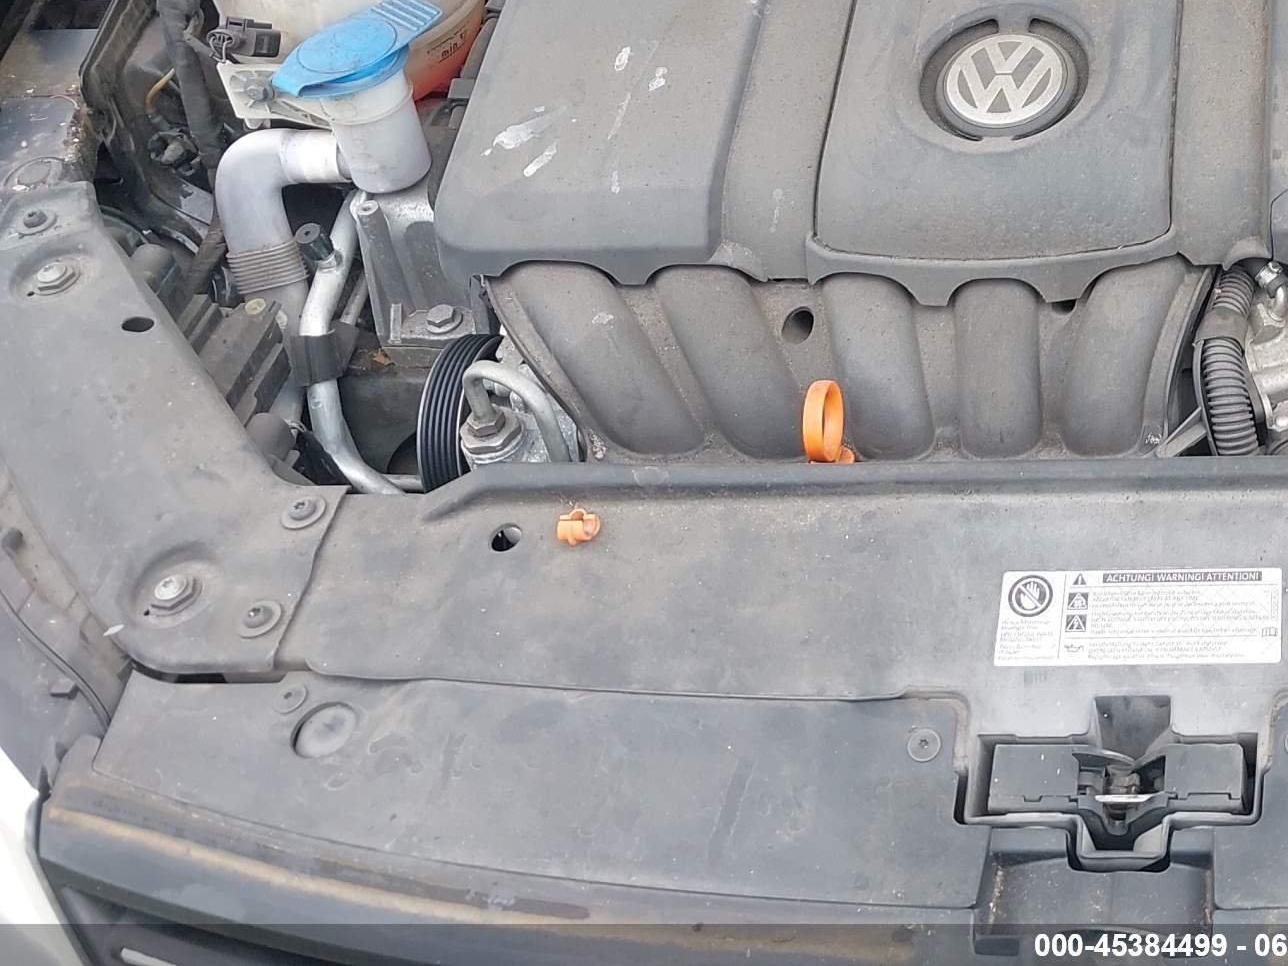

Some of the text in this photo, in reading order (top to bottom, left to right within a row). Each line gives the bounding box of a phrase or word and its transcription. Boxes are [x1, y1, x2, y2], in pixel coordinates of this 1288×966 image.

[441, 42, 458, 58] min
[945, 33, 1064, 126] VW
[1106, 572, 1259, 583] ACHTUNG! WARNING! ATTENTION!
